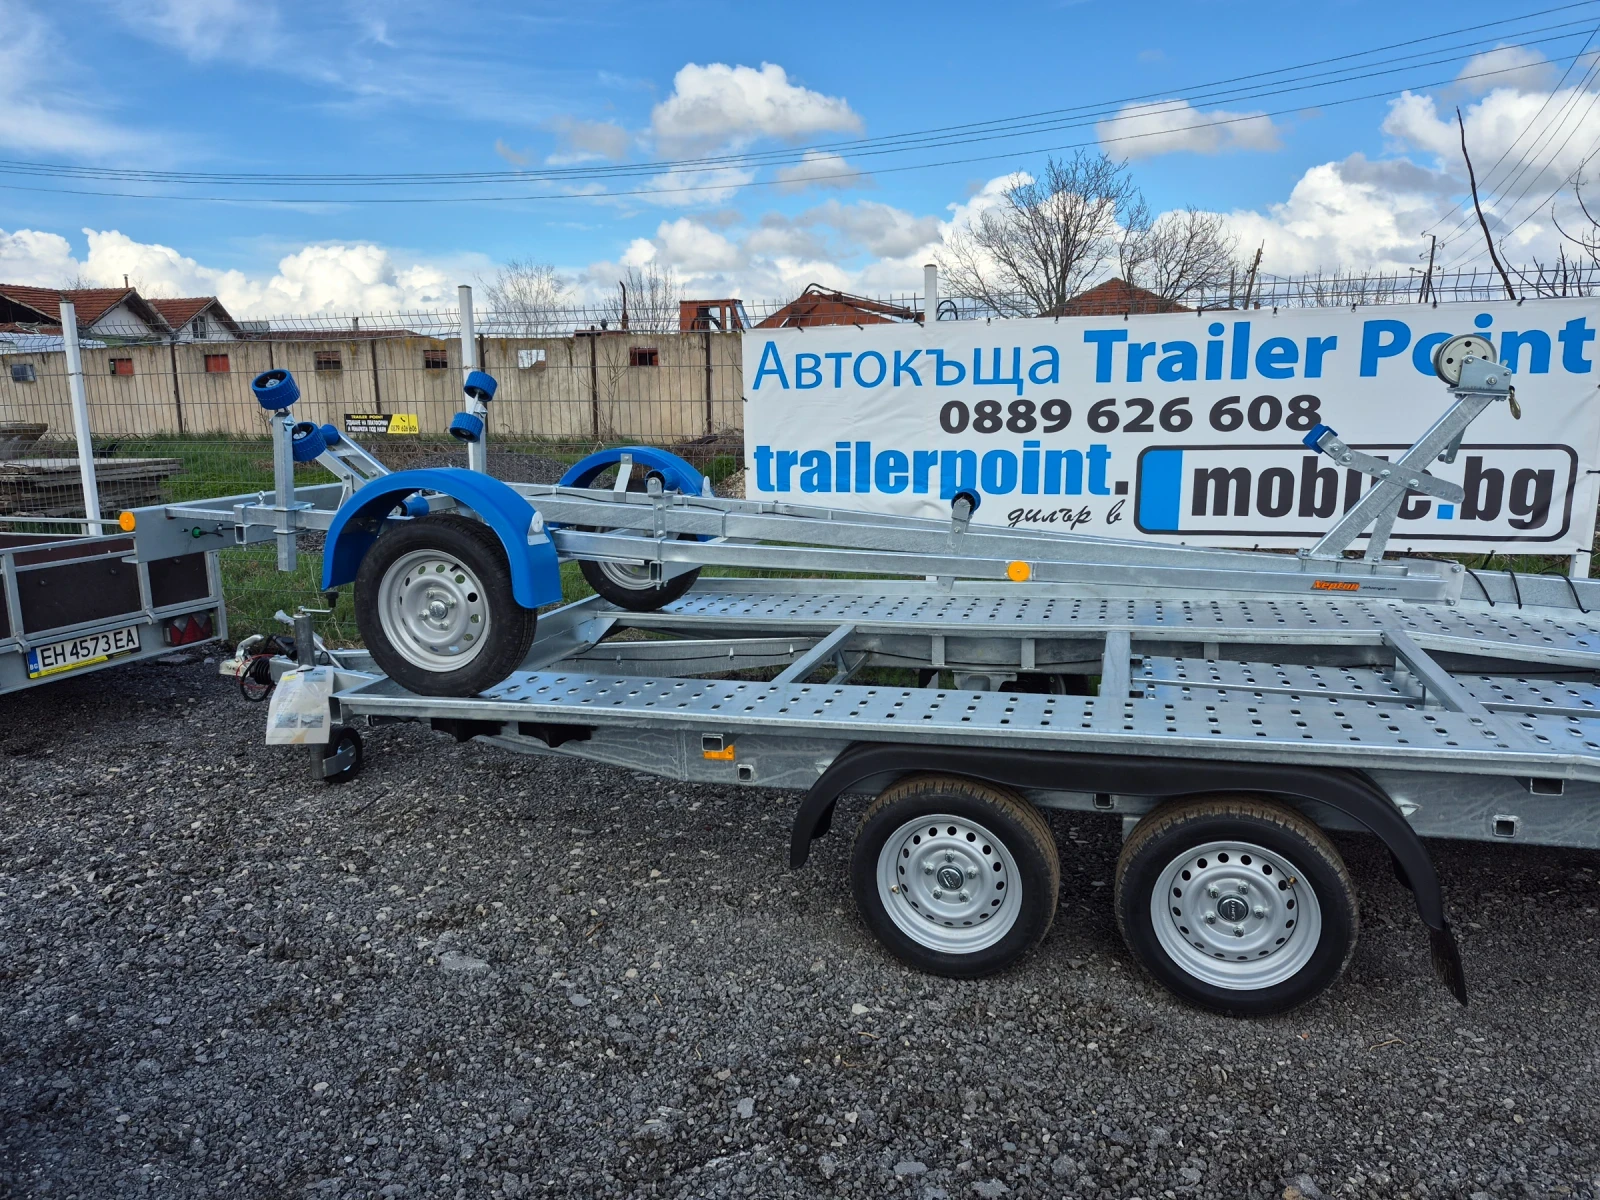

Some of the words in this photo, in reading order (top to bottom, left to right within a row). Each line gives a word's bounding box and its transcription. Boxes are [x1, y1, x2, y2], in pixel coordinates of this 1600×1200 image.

[752, 340, 1060, 396] Автокъща
[1083, 321, 1338, 383] Trailer
[939, 399, 1072, 434] 0889
[1087, 397, 1193, 433] 626
[1209, 395, 1322, 432] 608
[1007, 506, 1092, 530] дилър
[1106, 499, 1126, 525] в
